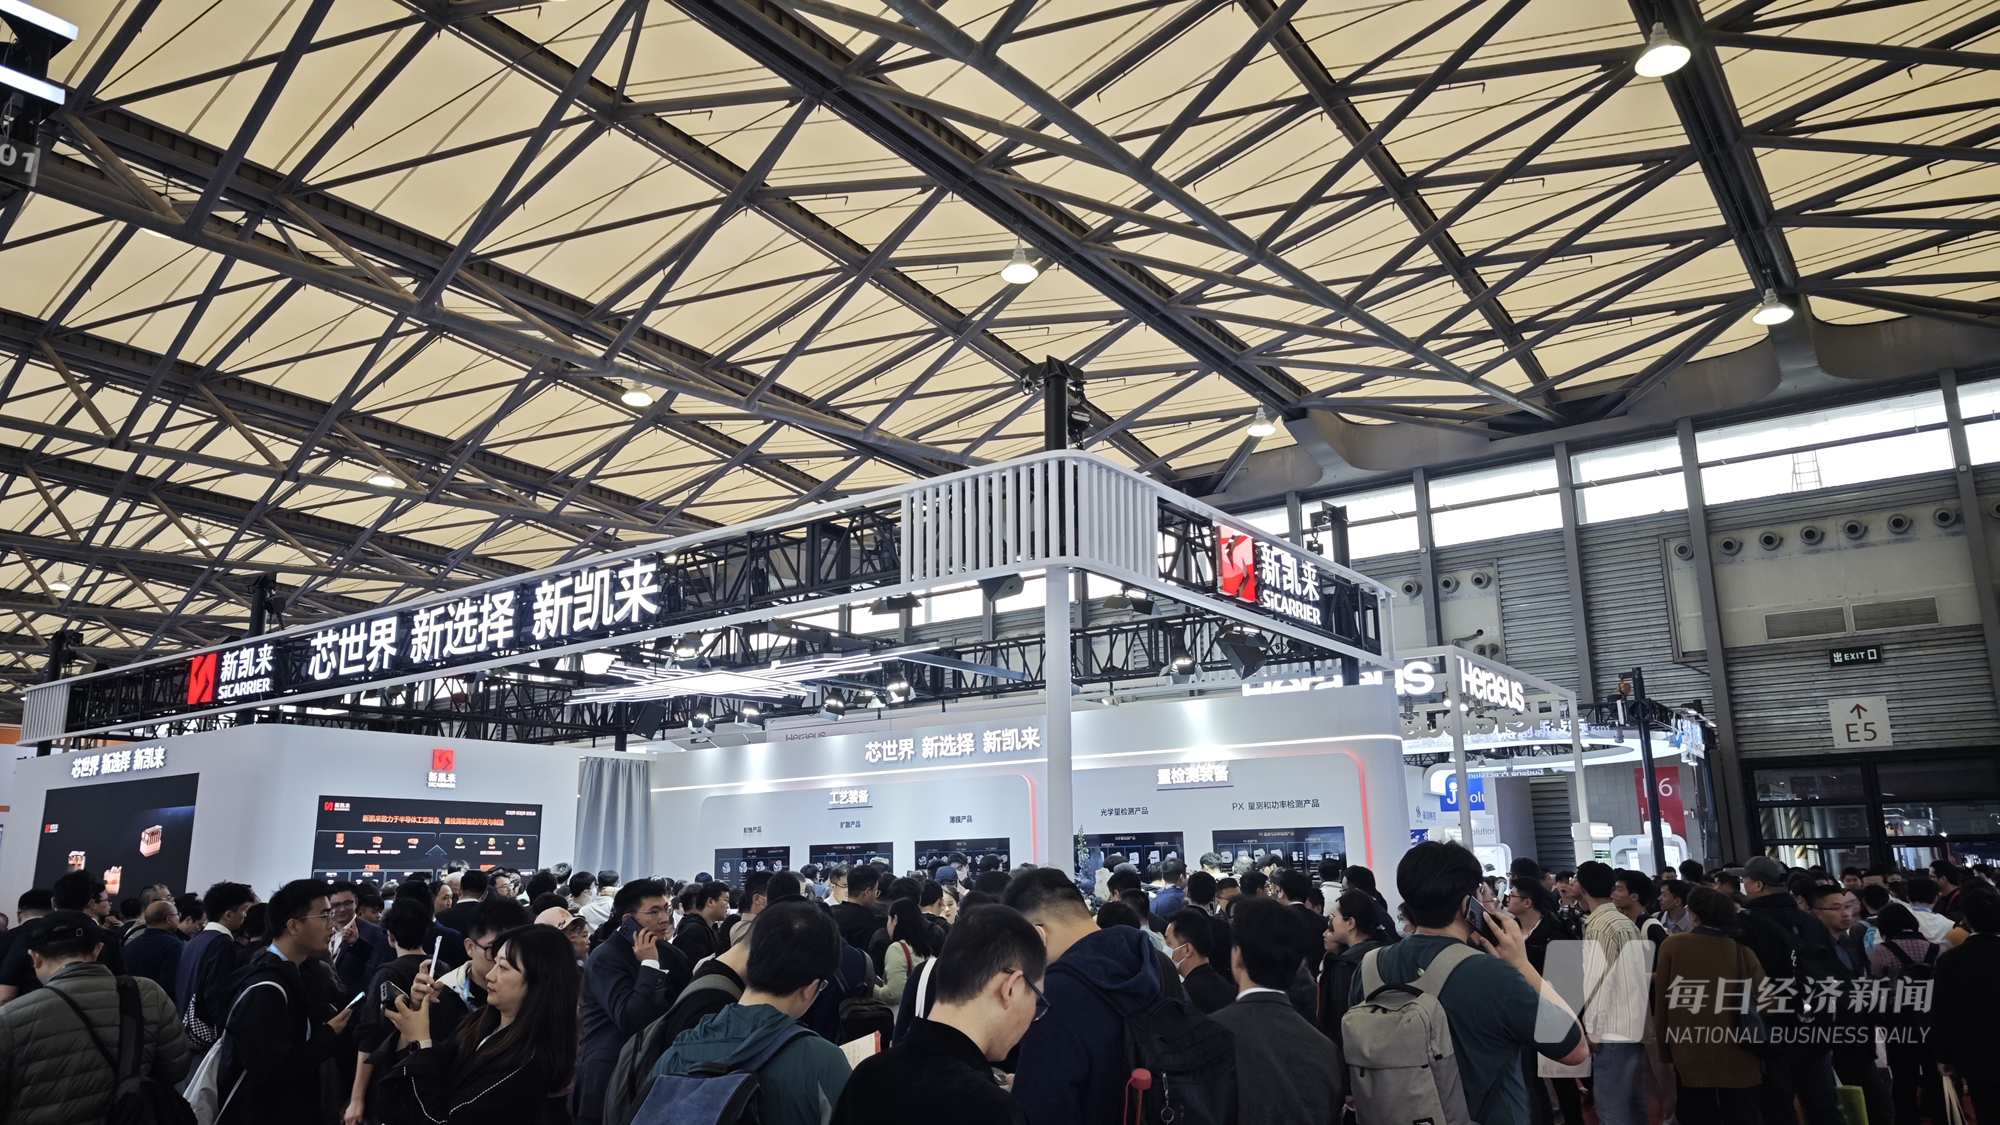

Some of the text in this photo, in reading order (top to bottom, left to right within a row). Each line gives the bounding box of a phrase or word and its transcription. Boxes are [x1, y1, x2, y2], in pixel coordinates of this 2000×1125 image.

[1260, 543, 1320, 601] 新凯来
[1262, 590, 1321, 625] SiCARRIER
[308, 558, 660, 681] 芯世界 新选择 新凯来
[1486, 626, 1498, 636] 13
[220, 643, 274, 682] 新凯来
[1833, 652, 1842, 663] 出
[1844, 652, 1865, 661] EXIT
[217, 678, 271, 700] SiCARRIER
[1456, 655, 1524, 712] Heraeus
[1846, 722, 1877, 742] E5
[865, 726, 1041, 763] 芯世界 新选择 新凯来
[71, 746, 166, 779] 芯世界 新选择 新凯来
[1157, 765, 1229, 785] 量检测装备
[828, 789, 870, 805] 工艺装备
[1232, 799, 1320, 811] PX 量测和功率检测产品
[1100, 806, 1149, 817] 光学量检测产品
